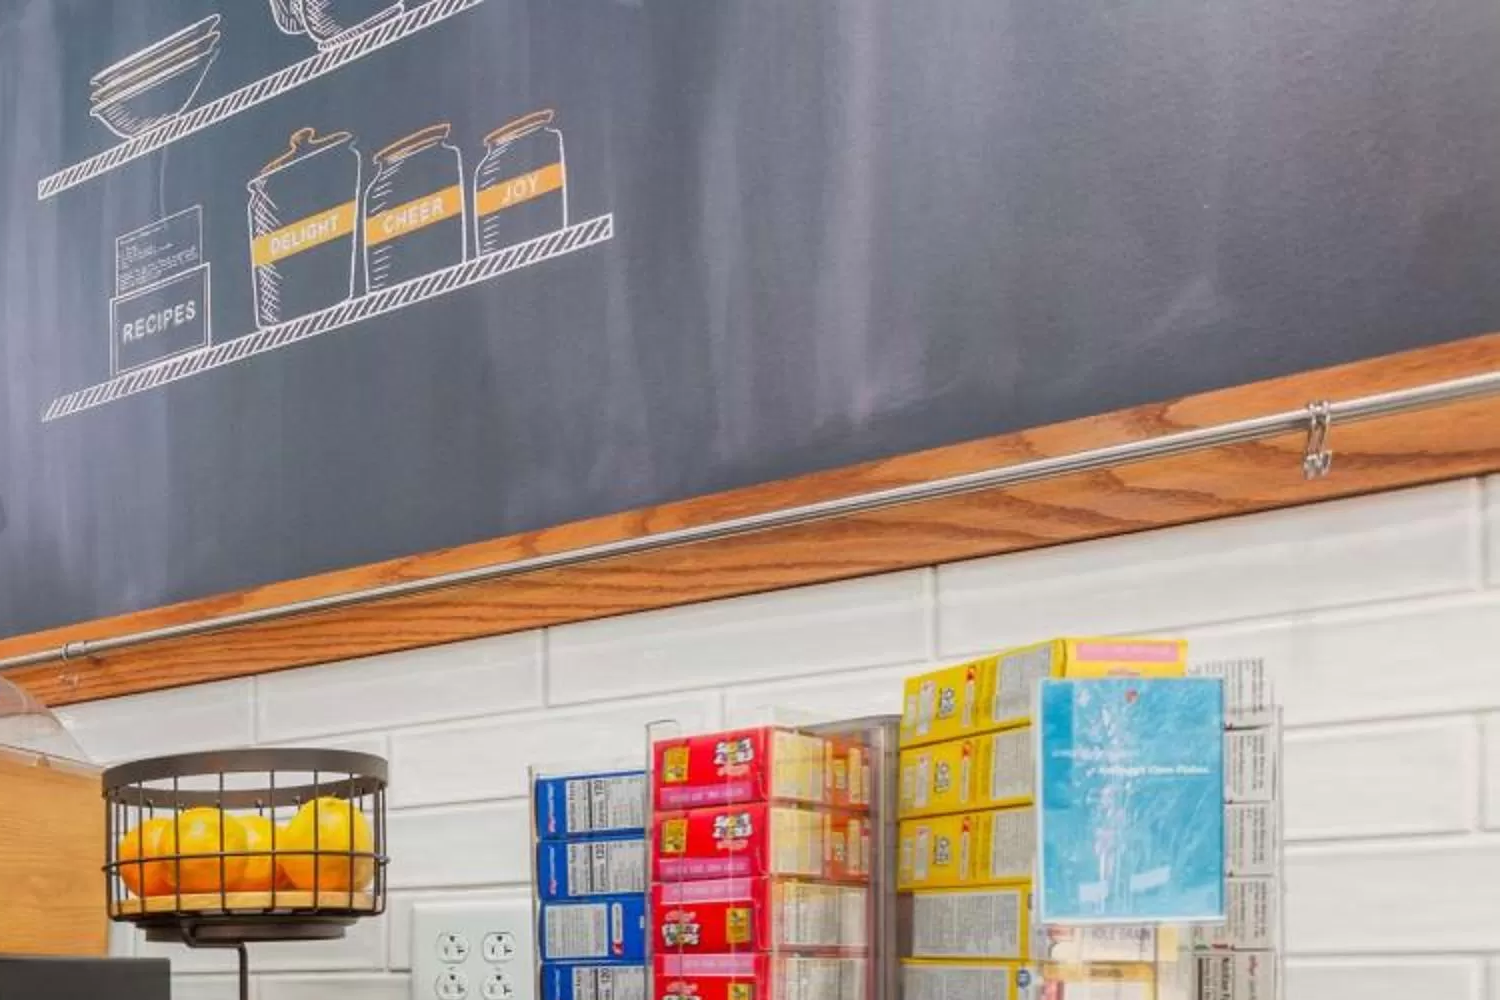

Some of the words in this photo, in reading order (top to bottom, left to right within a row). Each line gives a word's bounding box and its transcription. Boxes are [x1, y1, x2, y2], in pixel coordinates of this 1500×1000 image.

[502, 174, 539, 203] JOY
[382, 198, 444, 233] CHEER
[270, 216, 339, 255] DELIGHT
[123, 300, 196, 343] RECIPES
